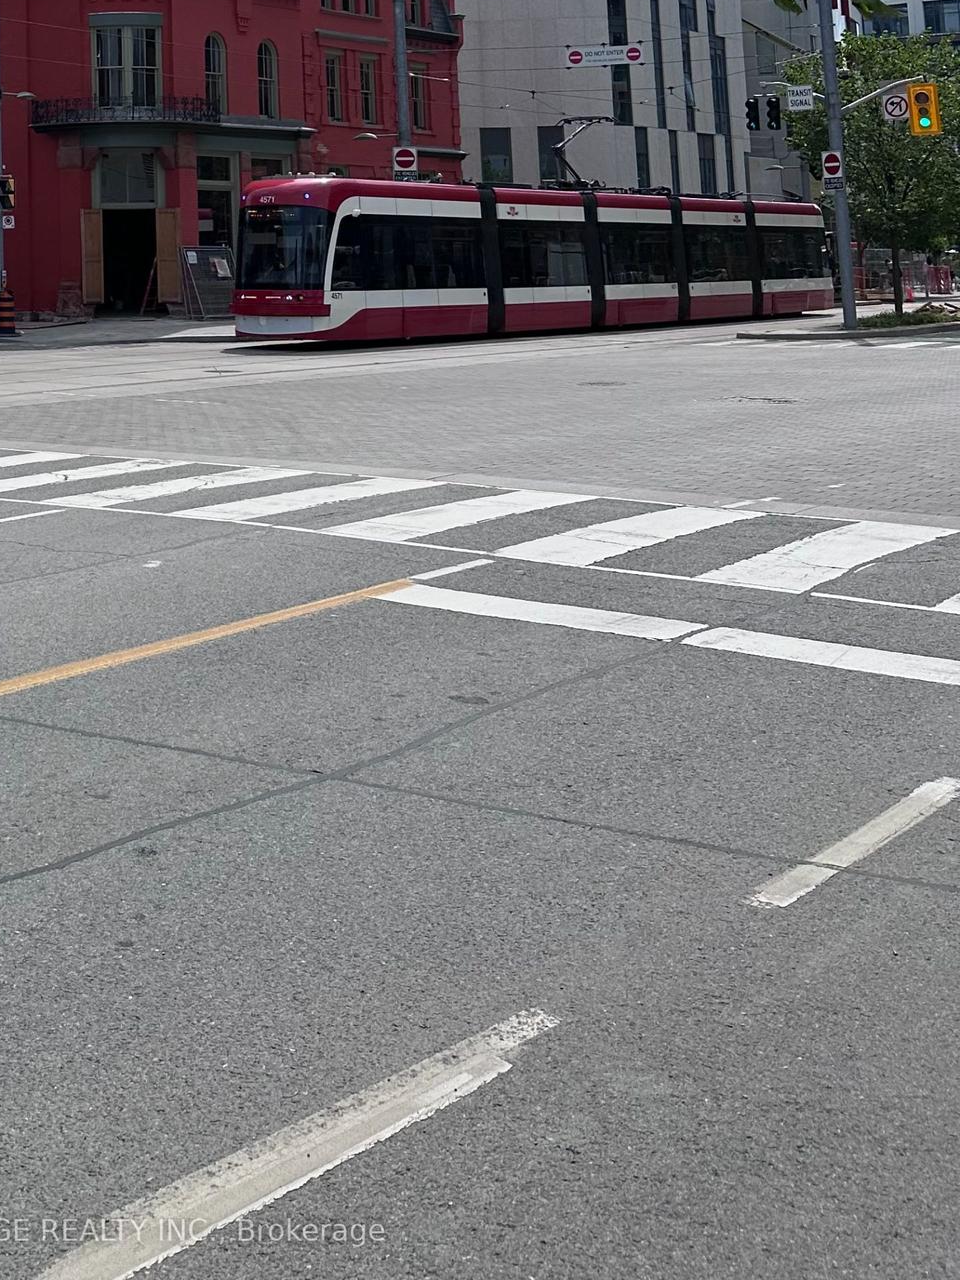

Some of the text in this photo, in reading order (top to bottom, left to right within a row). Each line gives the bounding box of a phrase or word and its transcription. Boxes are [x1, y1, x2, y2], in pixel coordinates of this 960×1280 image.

[788, 88, 811, 97] TRANSIT
[790, 99, 811, 107] SIGNAL
[260, 195, 275, 204] 4571
[331, 292, 343, 300] 4571
